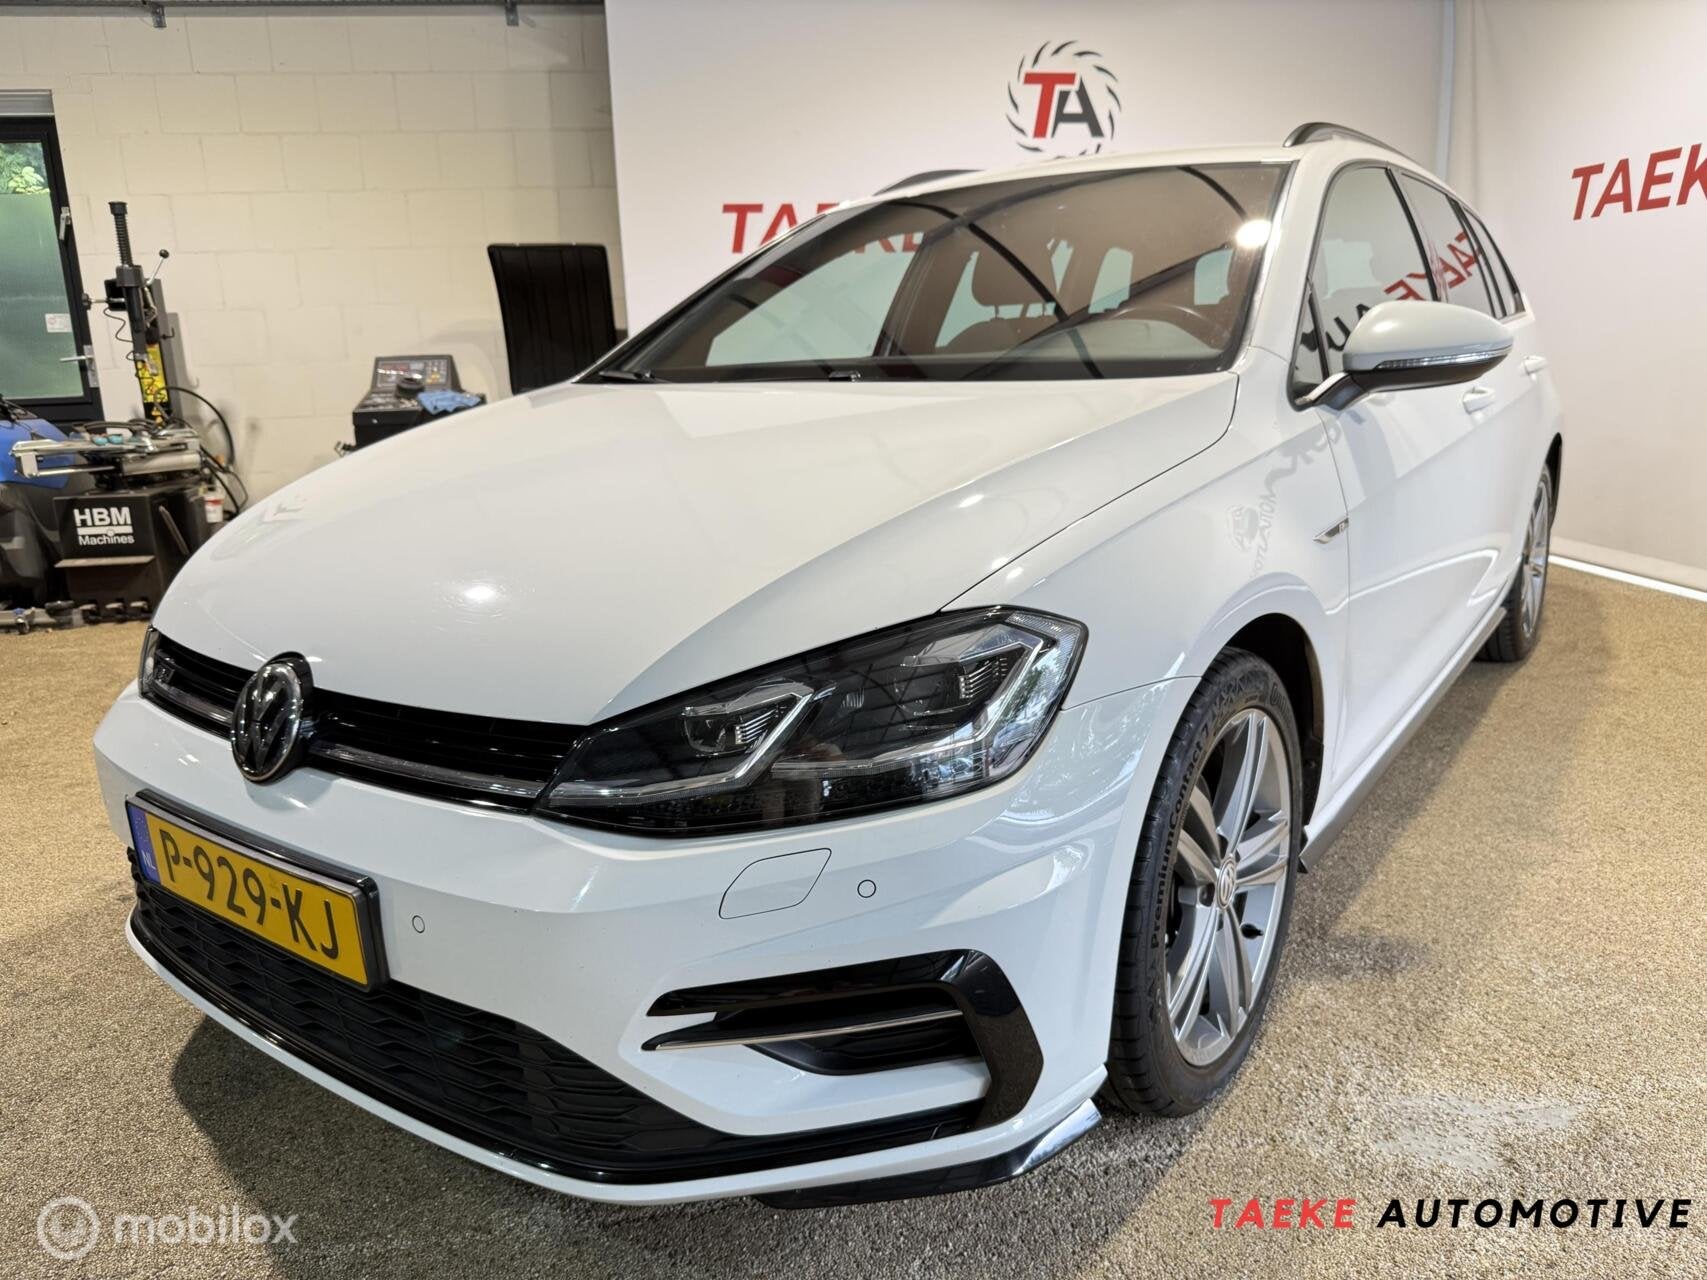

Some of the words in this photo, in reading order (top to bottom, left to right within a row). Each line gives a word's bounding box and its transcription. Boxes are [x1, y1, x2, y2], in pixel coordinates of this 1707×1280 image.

[1023, 72, 1105, 139] TA
[73, 506, 132, 527] HBM
[78, 534, 136, 546] Machines
[1151, 740, 1203, 949] PremiumContact
[159, 828, 340, 961] P-929-KJ
